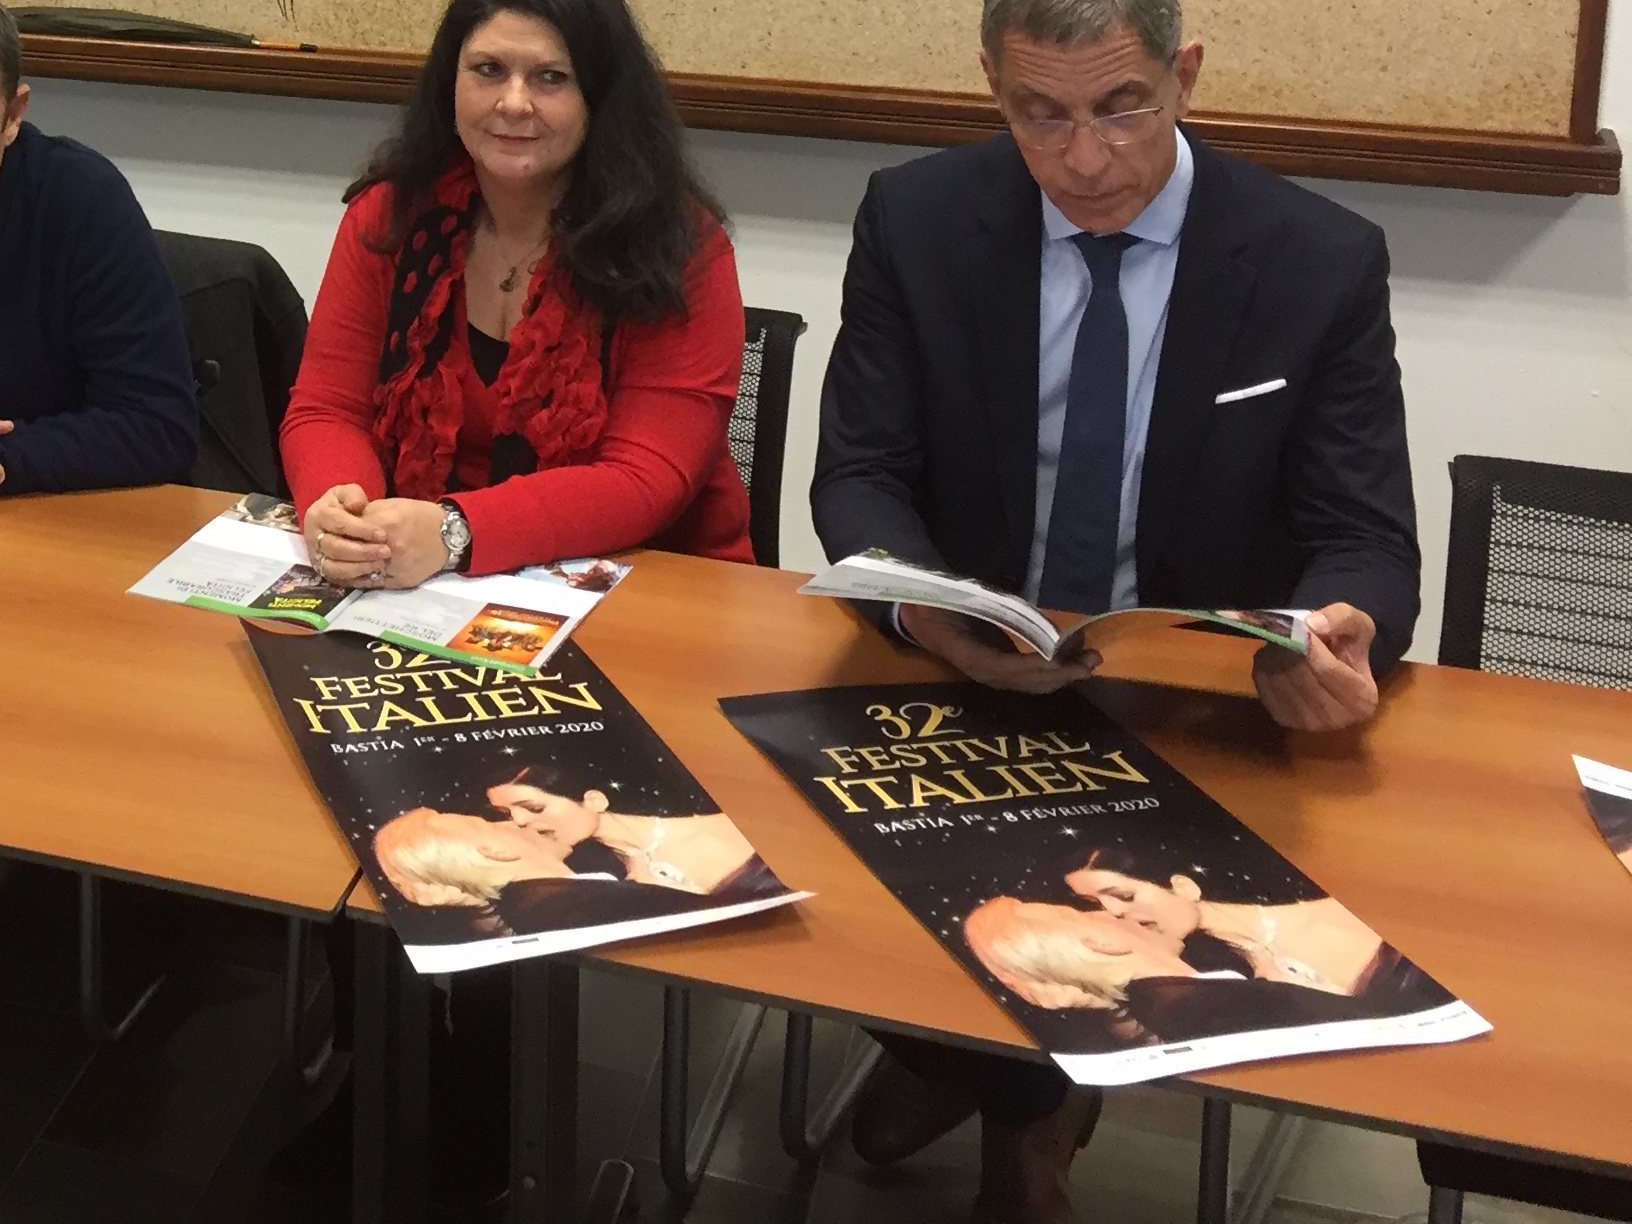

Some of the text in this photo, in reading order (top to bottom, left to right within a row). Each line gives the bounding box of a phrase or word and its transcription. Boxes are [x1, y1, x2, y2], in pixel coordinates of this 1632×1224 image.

[366, 640, 451, 670] 32
[292, 682, 603, 734] ITALIEN
[330, 738, 406, 755] BASTIA
[454, 731, 468, 744] 8
[471, 722, 554, 743] FÉVRIER
[554, 720, 605, 736] 2020
[820, 731, 1091, 773] FESTIVAL
[813, 750, 1150, 813] ITALIEN
[874, 815, 955, 835] BASTIA
[1003, 810, 1019, 824] 8
[1020, 801, 1108, 822] FÉVRIER
[1107, 796, 1161, 814] 2020
